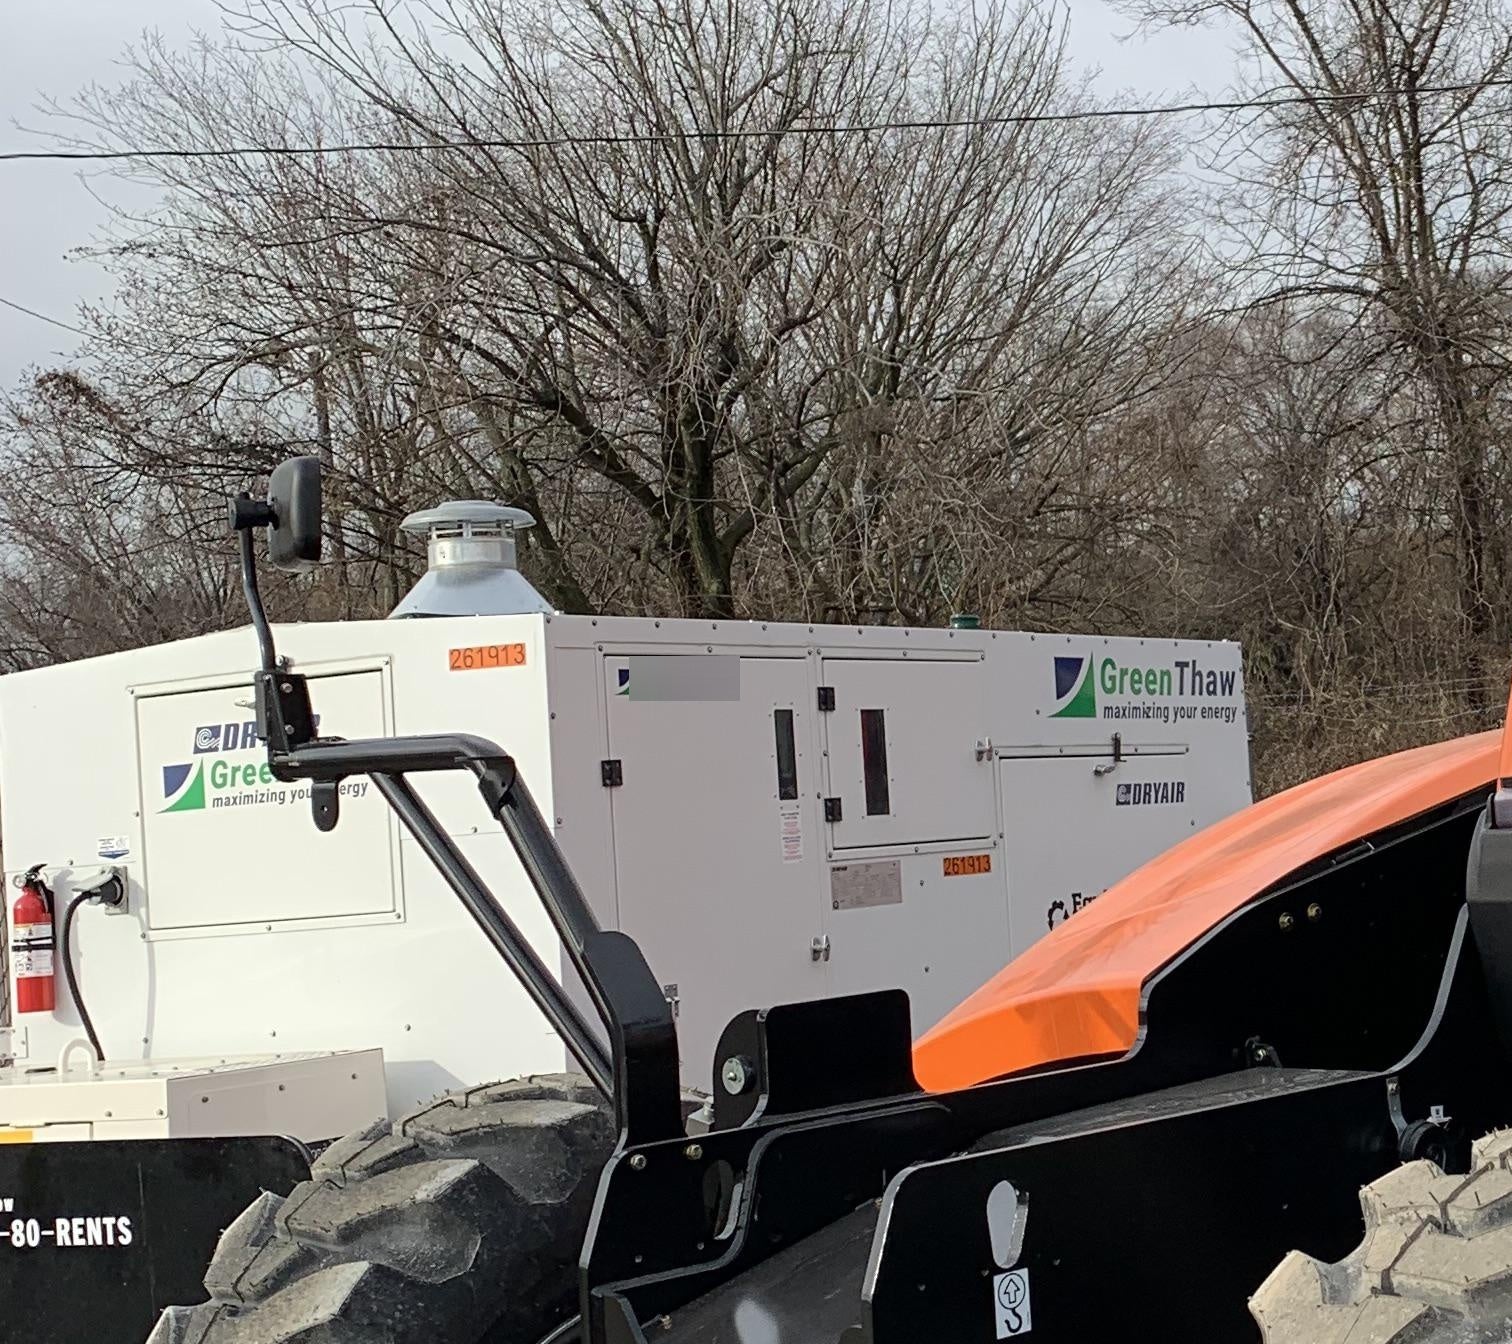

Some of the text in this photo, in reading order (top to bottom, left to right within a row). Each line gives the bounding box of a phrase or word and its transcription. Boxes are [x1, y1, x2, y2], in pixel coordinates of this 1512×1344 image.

[449, 643, 526, 670] 261913
[1103, 702, 1238, 723] maximizing your energy
[212, 780, 369, 809] maximizing you ergy
[1132, 781, 1185, 805] DRYAIR
[943, 854, 992, 876] 261913
